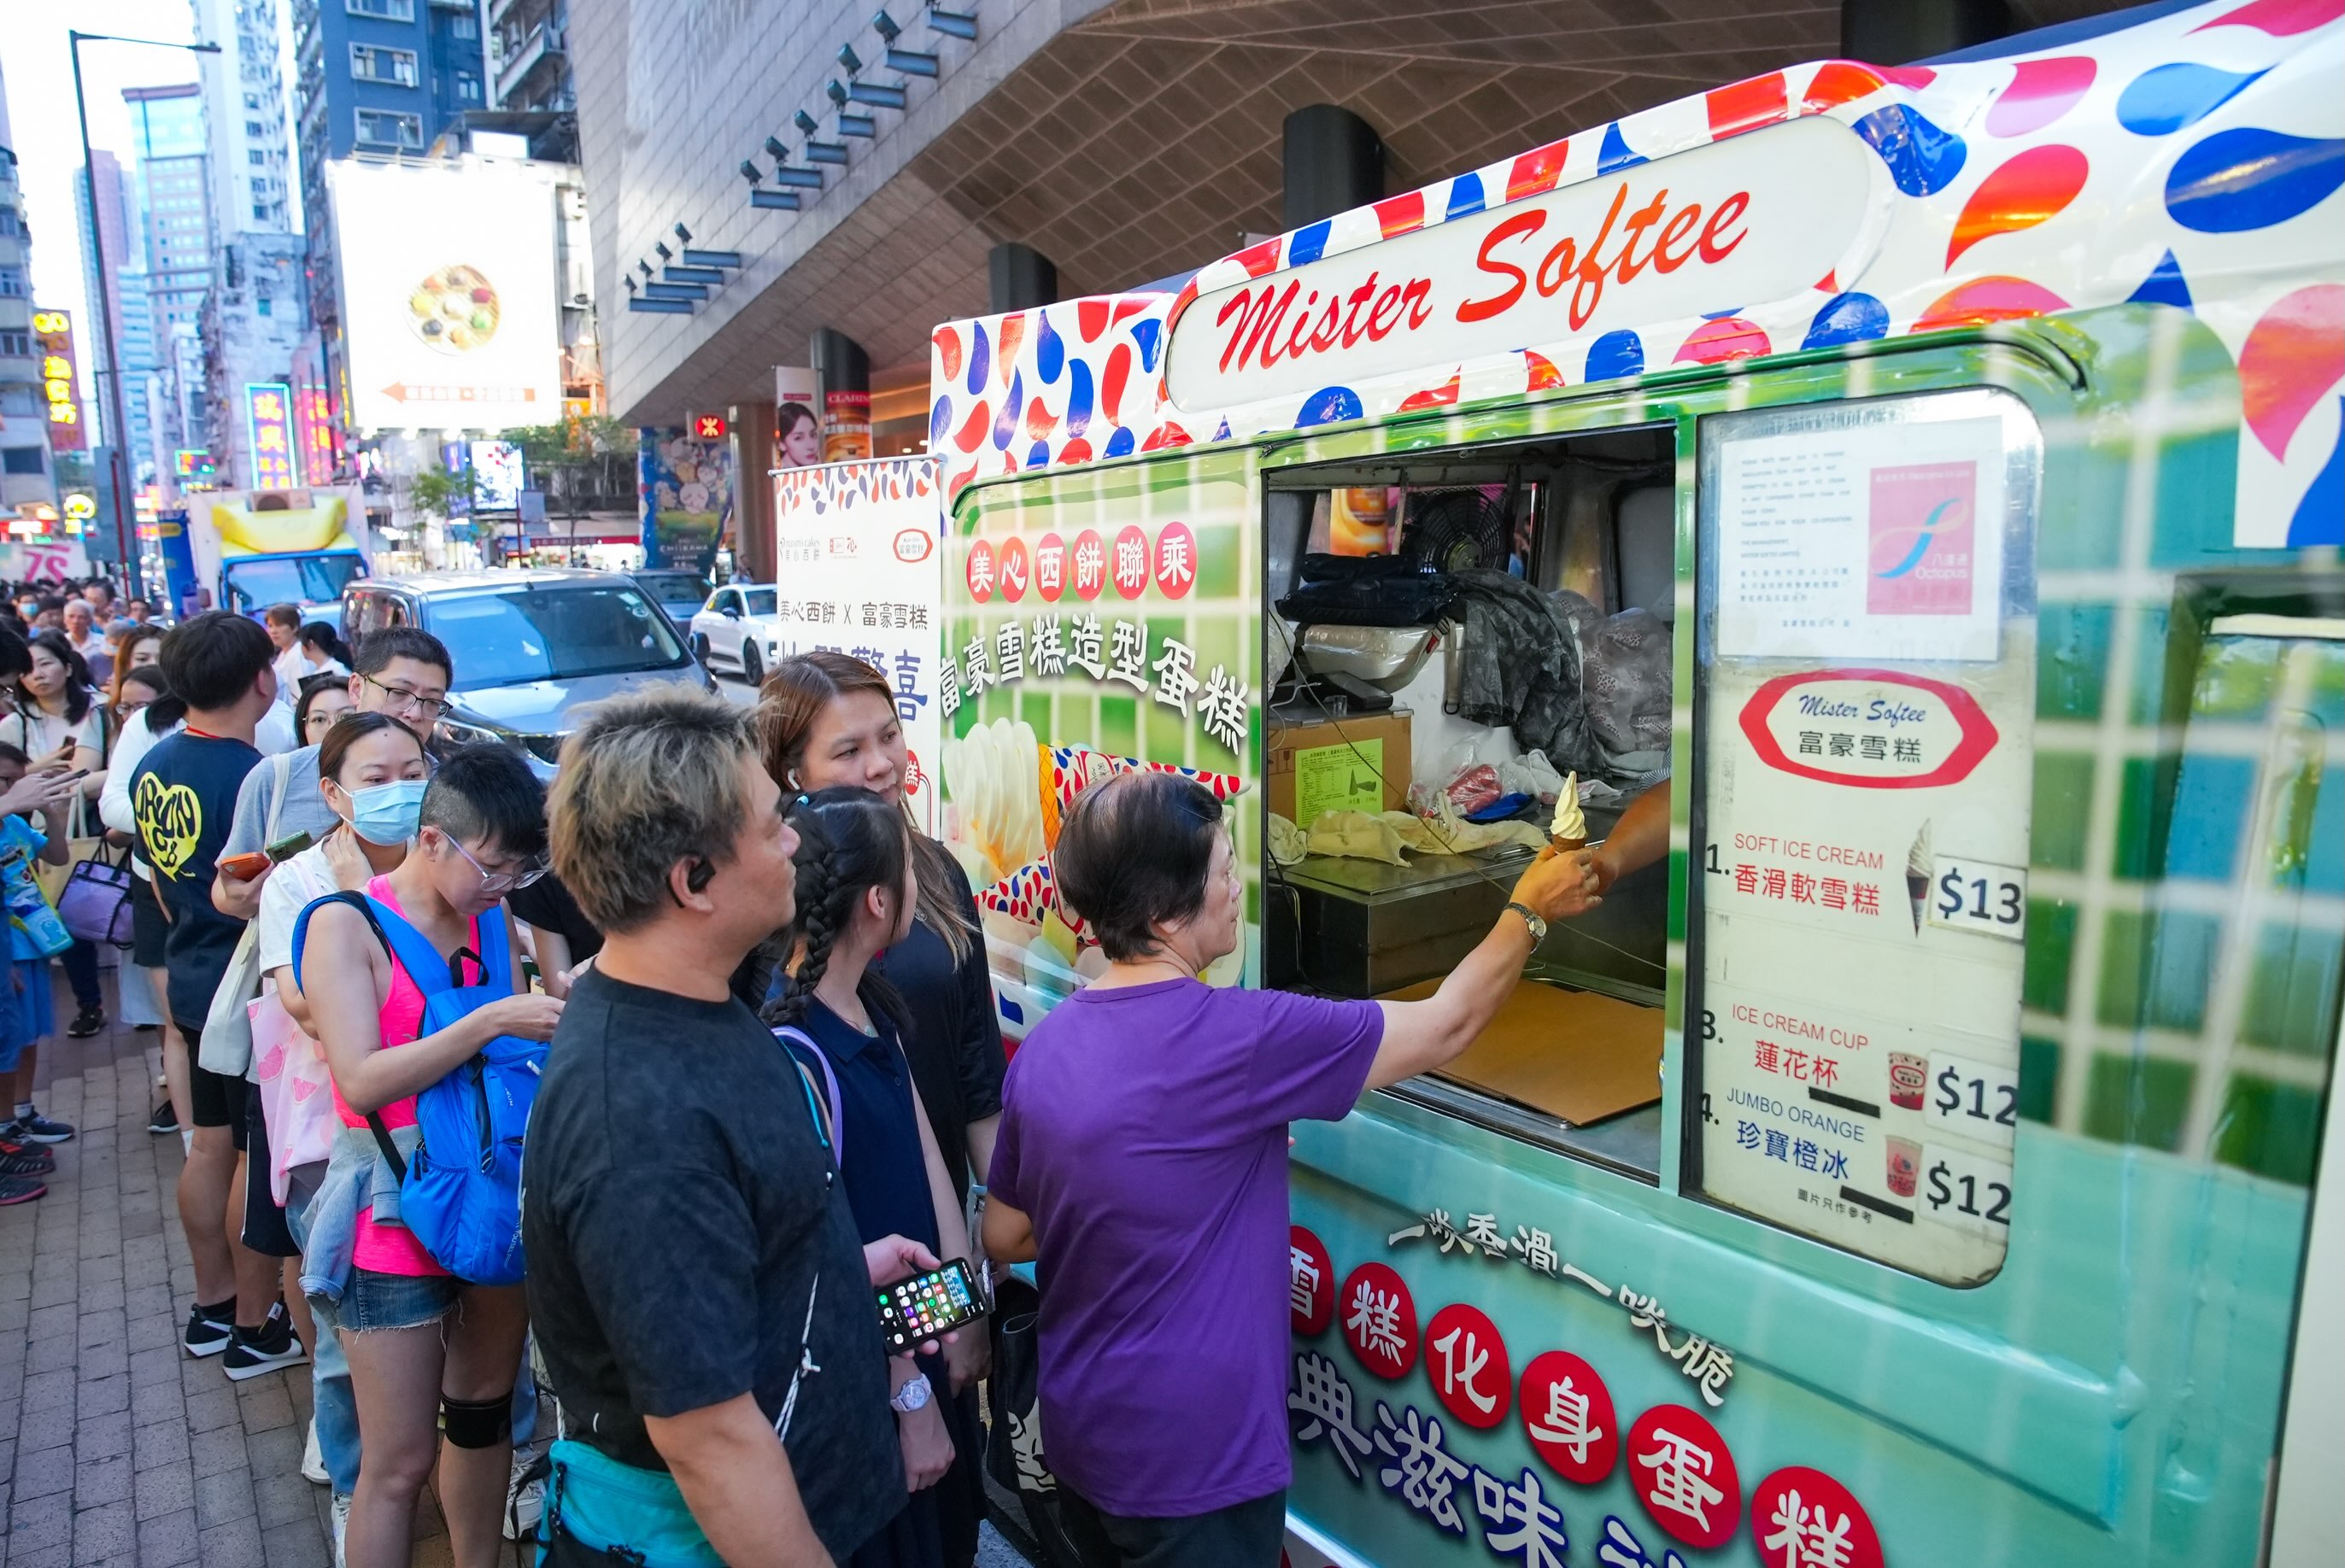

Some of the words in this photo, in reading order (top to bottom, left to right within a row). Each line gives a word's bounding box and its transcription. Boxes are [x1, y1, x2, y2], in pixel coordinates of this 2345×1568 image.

[1216, 271, 1433, 374] Mister
[1456, 182, 1750, 332] Softee
[970, 535, 1193, 596] 美心西餅聯乘
[1914, 567, 1968, 581] Octopus
[781, 599, 835, 624] 美心西餅
[862, 601, 929, 630] 富豪雪糕
[941, 612, 1249, 756] 富豪雪糕造型蛋糕
[1798, 694, 1860, 719] Mister
[1866, 699, 1926, 728] Softee
[1798, 730, 1922, 764] 富豪雪糕
[1707, 843, 1730, 876] 1.
[1734, 833, 1779, 854] SOFT
[1783, 840, 1812, 860] ICE
[1816, 845, 1885, 870] CREAM
[1734, 863, 1880, 916] 香滑軟雪糕
[1938, 867, 2023, 925] $13
[1732, 1003, 1759, 1026] ICE
[1762, 1012, 1825, 1042] CREAM
[1829, 1029, 1869, 1051] CUP
[1754, 1039, 1839, 1089] 蓮花杯
[1727, 1086, 1784, 1117] JUMBO
[1787, 1106, 1866, 1143] ORANGE
[1934, 1065, 2017, 1128] $12
[1736, 1120, 1850, 1180] 珍寶橙冰
[1797, 1188, 1873, 1224] 圖片只作參考
[1926, 1160, 2011, 1226] $12
[1290, 1247, 1854, 1568] 雪糕化身蛋糕
[1288, 1354, 1687, 1568] 典滋味
